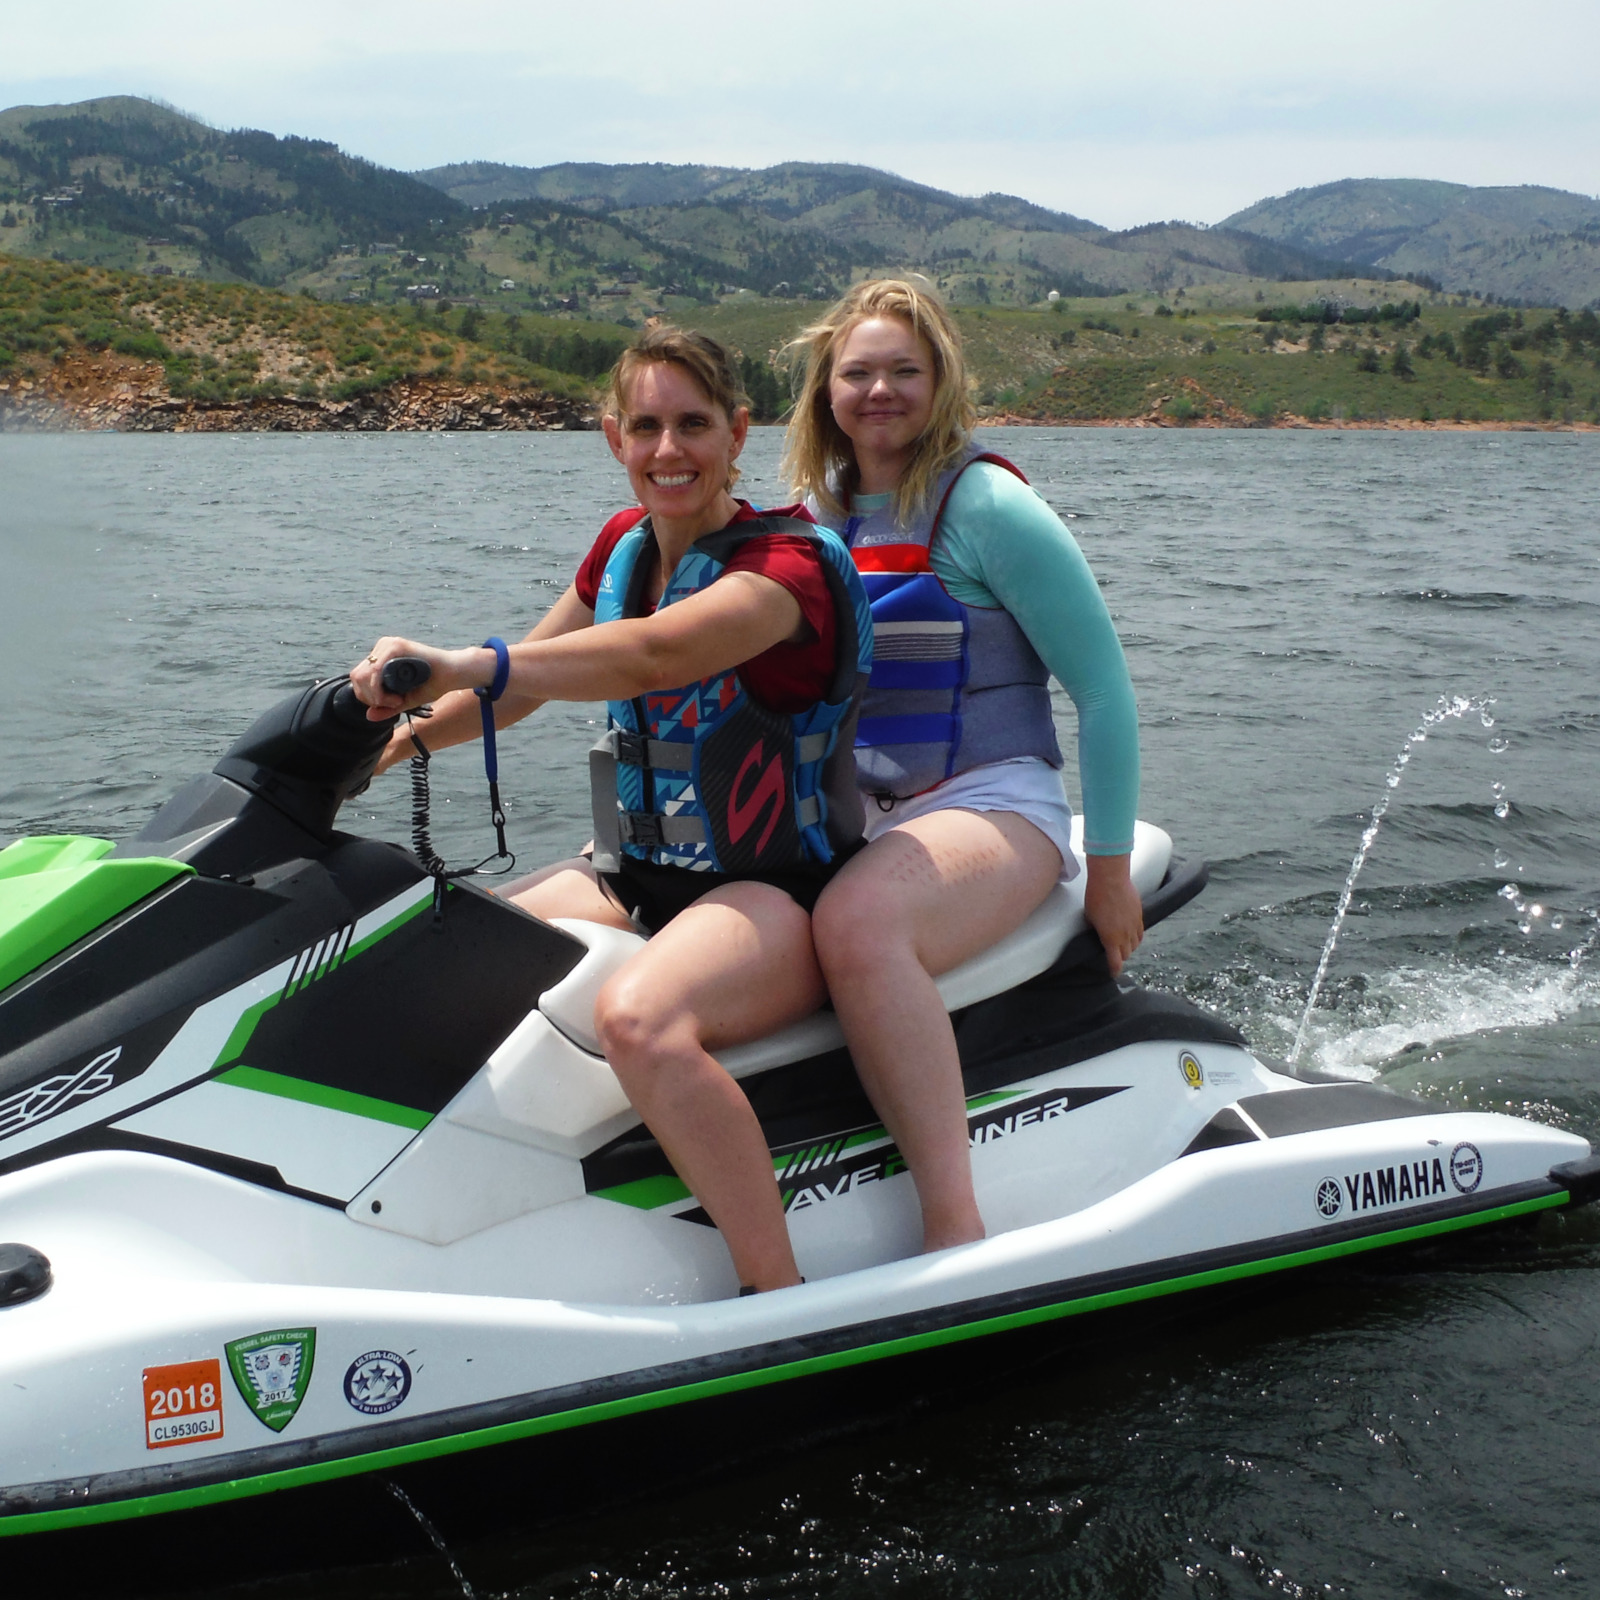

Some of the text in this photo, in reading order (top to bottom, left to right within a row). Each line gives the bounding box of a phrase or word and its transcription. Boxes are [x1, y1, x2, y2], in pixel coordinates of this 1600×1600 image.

[1344, 1158, 1446, 1211] YAMAHA
[234, 1332, 308, 1351] VESSEL SAFETY CHECK
[355, 1351, 402, 1368] ULTRA-LOW
[150, 1383, 215, 1415] 2018
[264, 1390, 287, 1401] 2017
[154, 1419, 215, 1440] CL9530GJ
